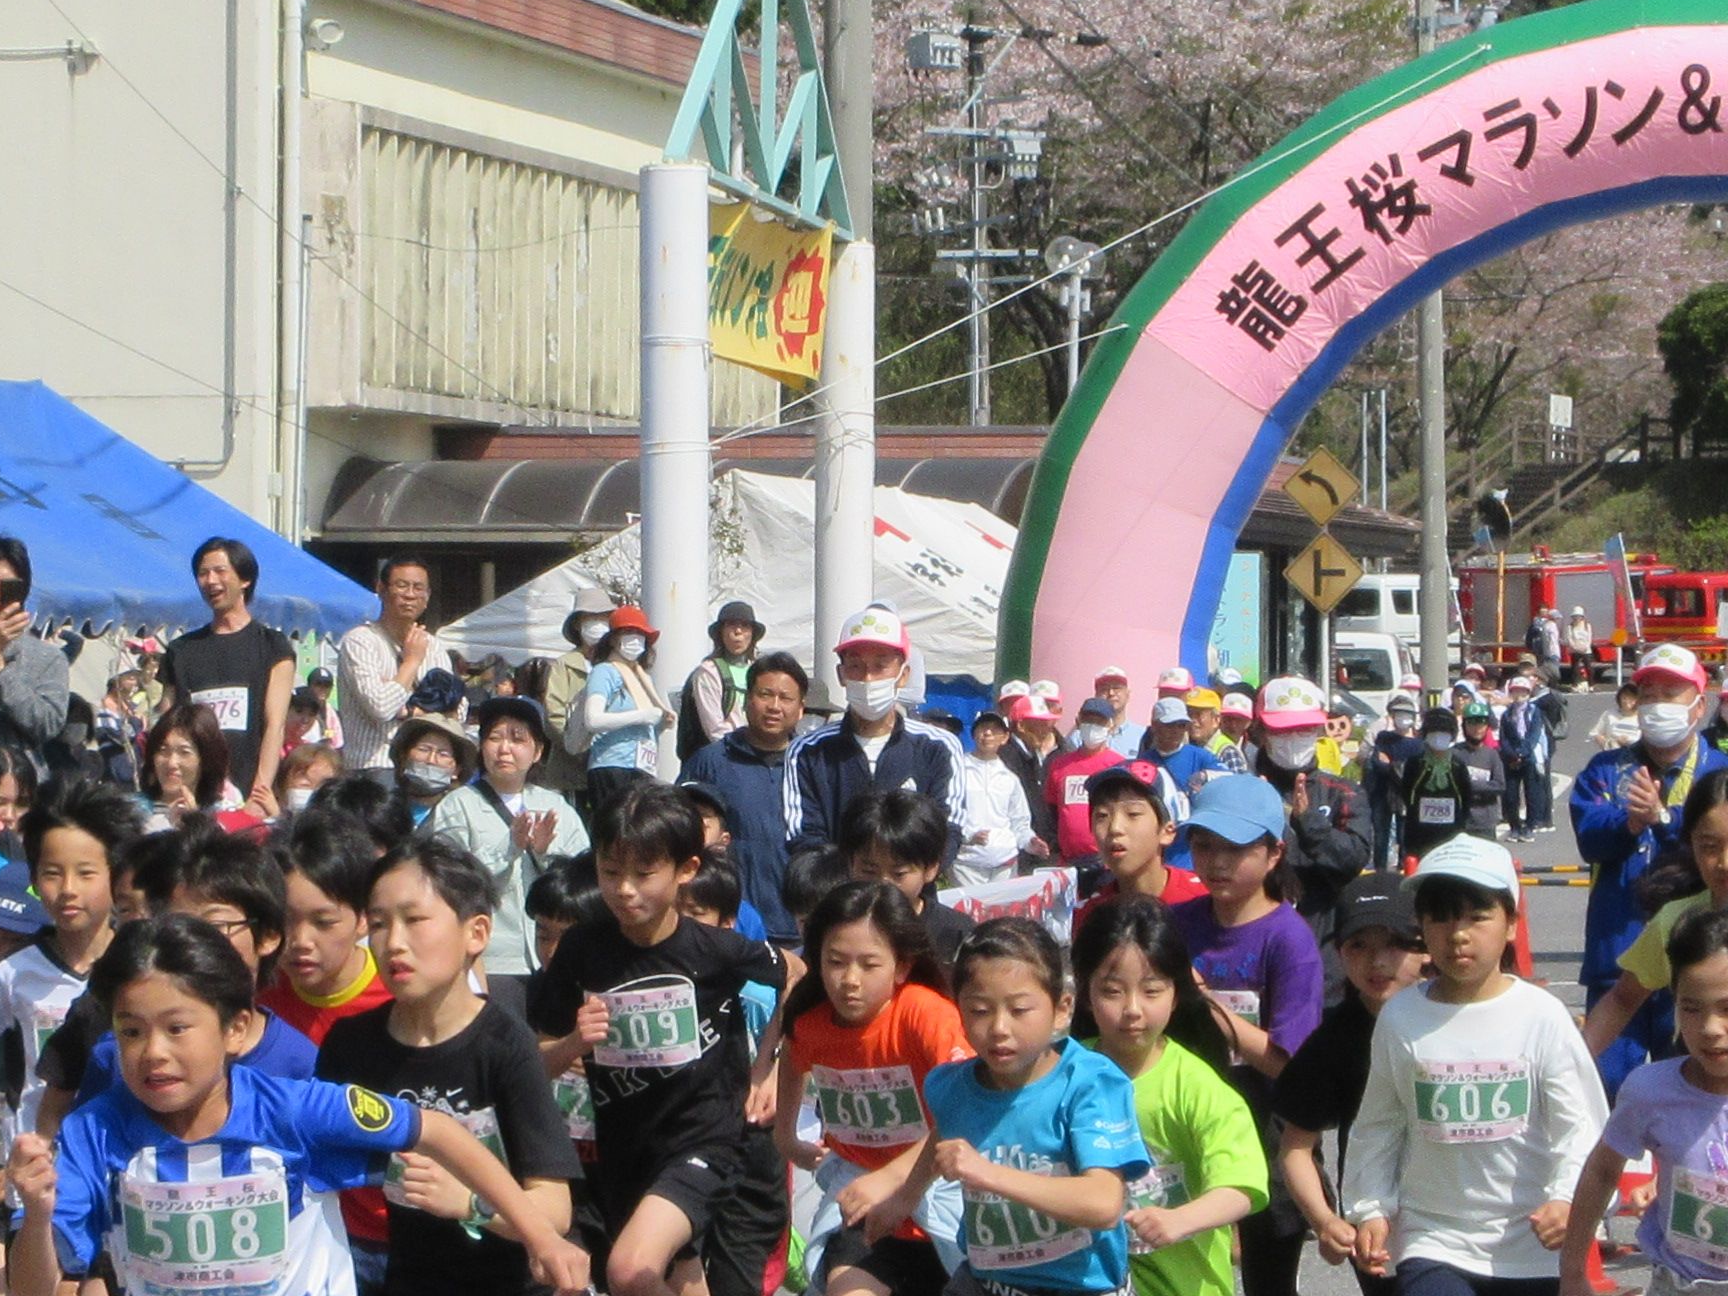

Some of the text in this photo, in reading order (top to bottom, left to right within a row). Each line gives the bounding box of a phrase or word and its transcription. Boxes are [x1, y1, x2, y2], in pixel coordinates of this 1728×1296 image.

[836, 1092, 902, 1129] 603
[1430, 1083, 1512, 1122] 606
[143, 1207, 261, 1263] 508
